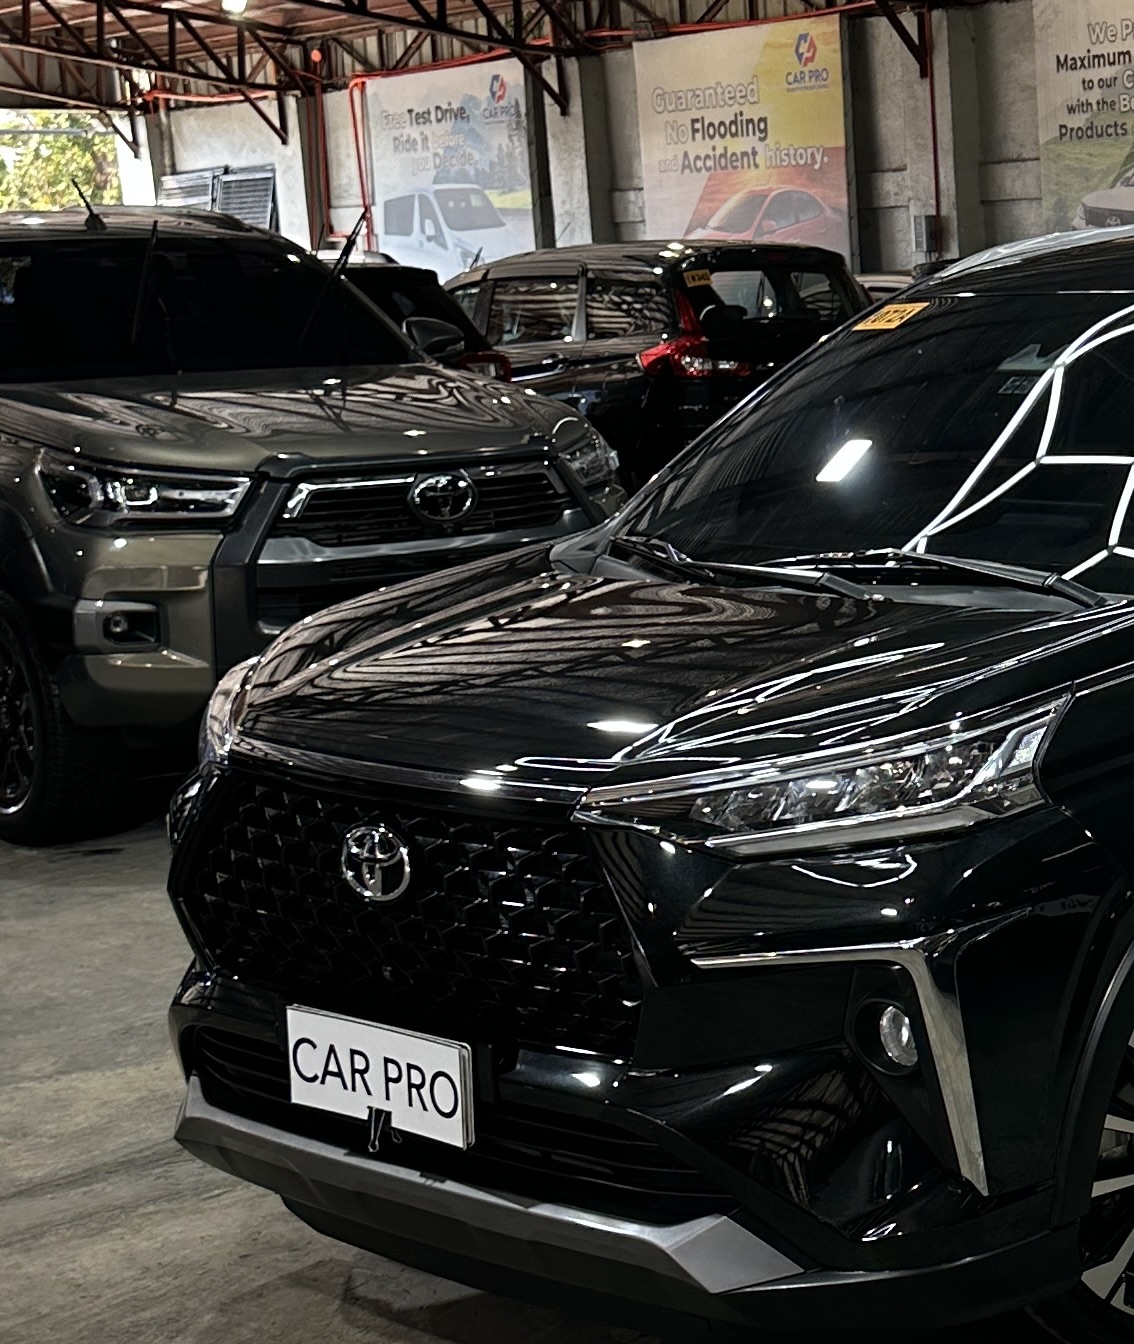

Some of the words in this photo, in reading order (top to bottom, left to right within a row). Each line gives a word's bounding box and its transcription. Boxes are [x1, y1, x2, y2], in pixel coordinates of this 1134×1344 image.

[1087, 22, 1118, 45] We
[1055, 48, 1132, 74] Maximum
[785, 70, 806, 86] CAR
[808, 67, 830, 83] PRO
[1081, 77, 1095, 92] to
[1098, 75, 1118, 89] our
[652, 75, 760, 114] Guaranteed
[1066, 97, 1094, 115] with
[1096, 96, 1116, 112] the
[407, 108, 432, 127] Test
[665, 119, 690, 146] No
[690, 111, 769, 143] Flooding
[1058, 119, 1128, 142] Products
[393, 132, 419, 154] Ride
[421, 131, 430, 151] it
[658, 155, 679, 174] and
[681, 145, 760, 175] Accident
[764, 143, 829, 170] history.
[292, 1037, 373, 1096] CAR
[383, 1056, 459, 1119] PRO
